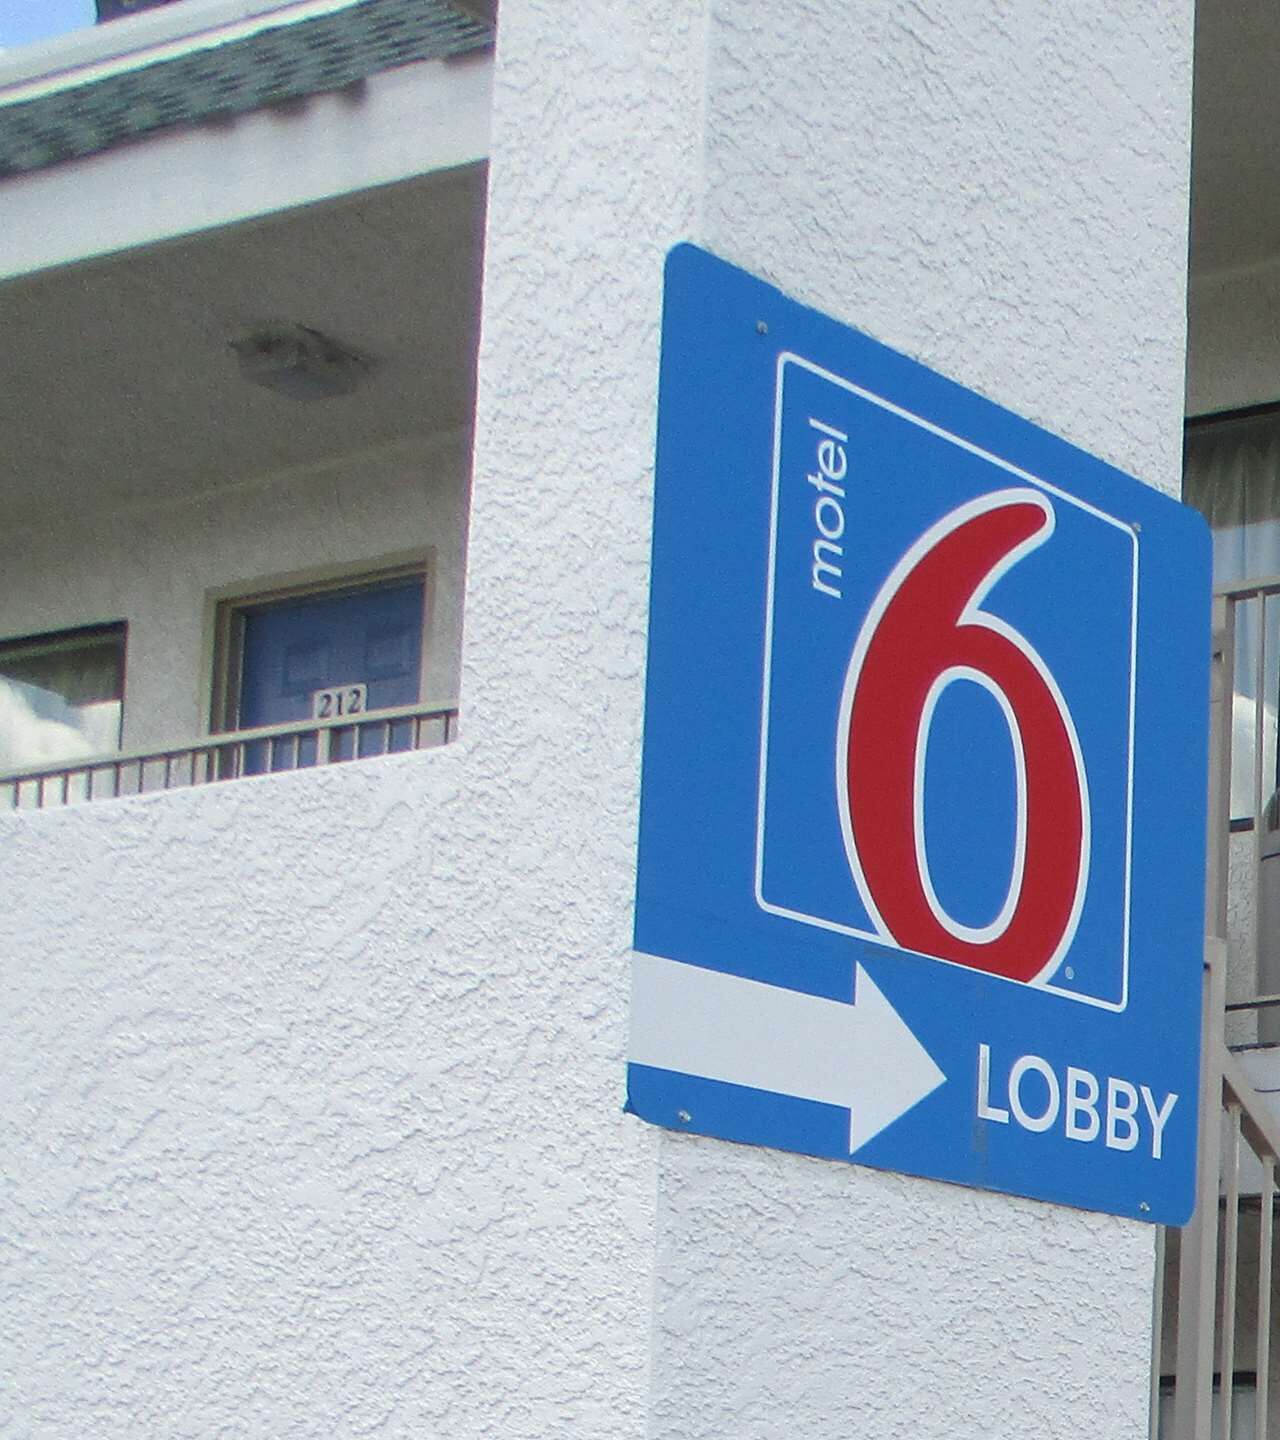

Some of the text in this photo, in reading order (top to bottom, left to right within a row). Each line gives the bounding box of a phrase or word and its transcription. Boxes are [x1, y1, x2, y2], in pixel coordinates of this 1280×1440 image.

[807, 417, 848, 600] motel
[318, 687, 361, 718] 212
[836, 487, 1090, 985] 6
[976, 1042, 1180, 1161] LOBBY
